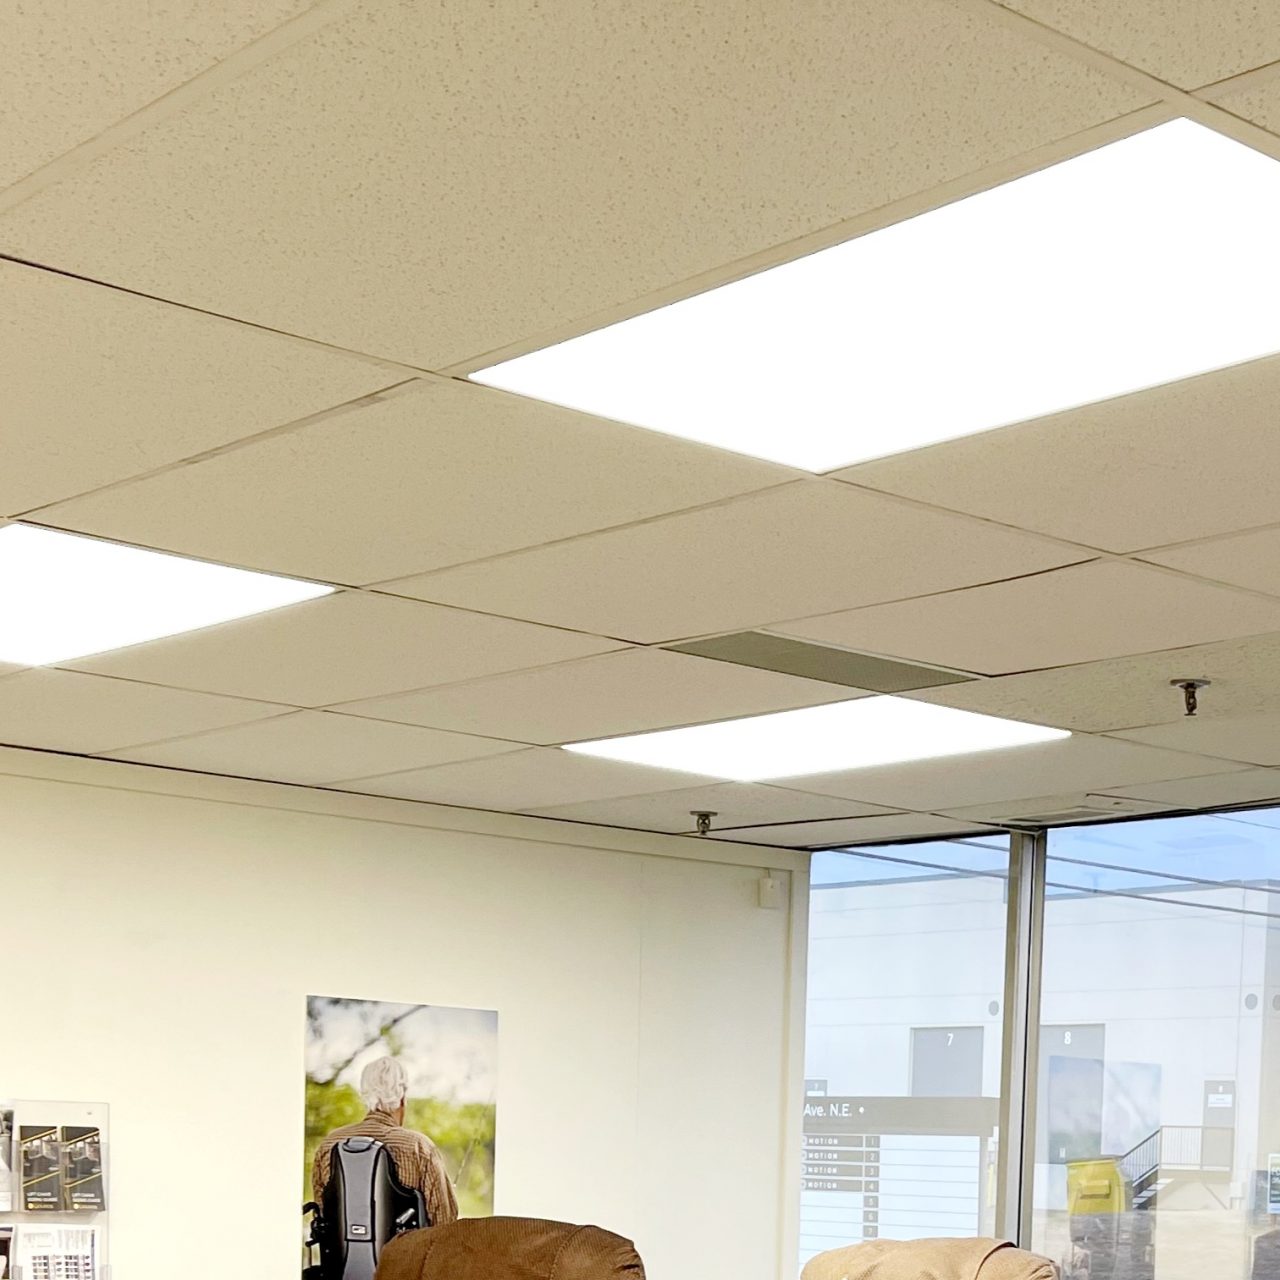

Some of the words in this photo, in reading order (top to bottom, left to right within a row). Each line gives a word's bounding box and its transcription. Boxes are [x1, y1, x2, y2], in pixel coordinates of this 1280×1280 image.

[947, 1032, 954, 1046] 7
[1064, 1031, 1071, 1045] 8
[803, 1103, 827, 1117] Ave.
[829, 1103, 852, 1117] N.E.
[808, 1152, 838, 1160] MOTION
[807, 1166, 838, 1174] MOTION
[807, 1181, 838, 1189] MOTION
